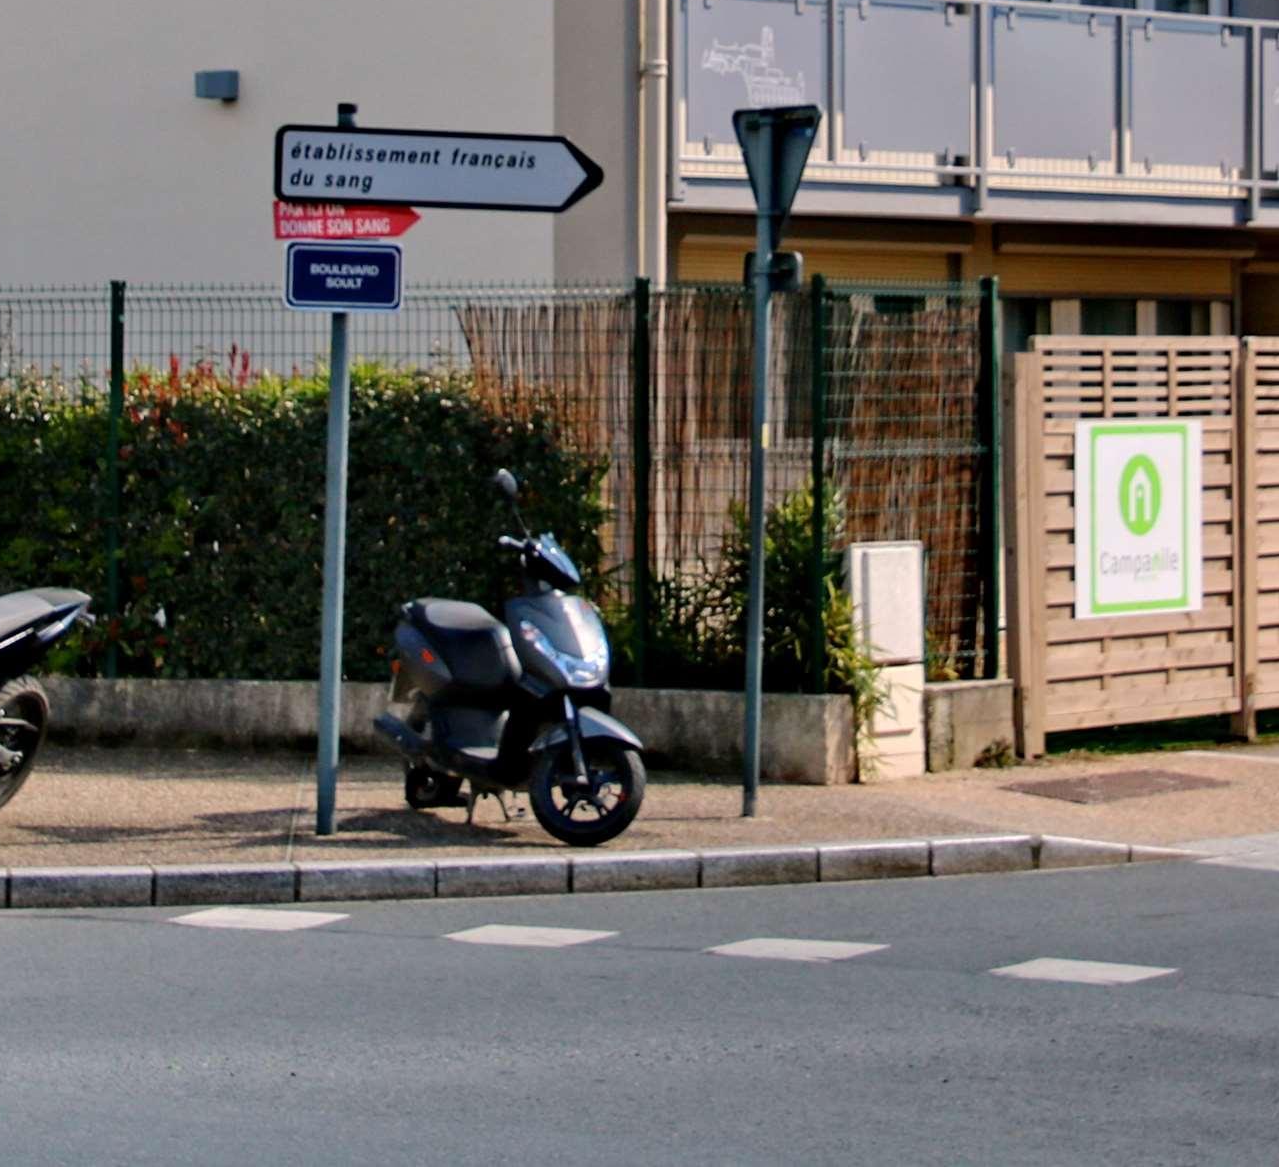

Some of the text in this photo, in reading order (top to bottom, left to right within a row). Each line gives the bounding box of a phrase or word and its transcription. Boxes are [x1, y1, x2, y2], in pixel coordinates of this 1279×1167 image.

[291, 141, 536, 169] établissement français
[290, 168, 373, 194] du sang
[280, 217, 391, 235] DONNE SON SANG
[310, 262, 380, 276] BOULEVARD
[1100, 546, 1179, 579] Campanile
